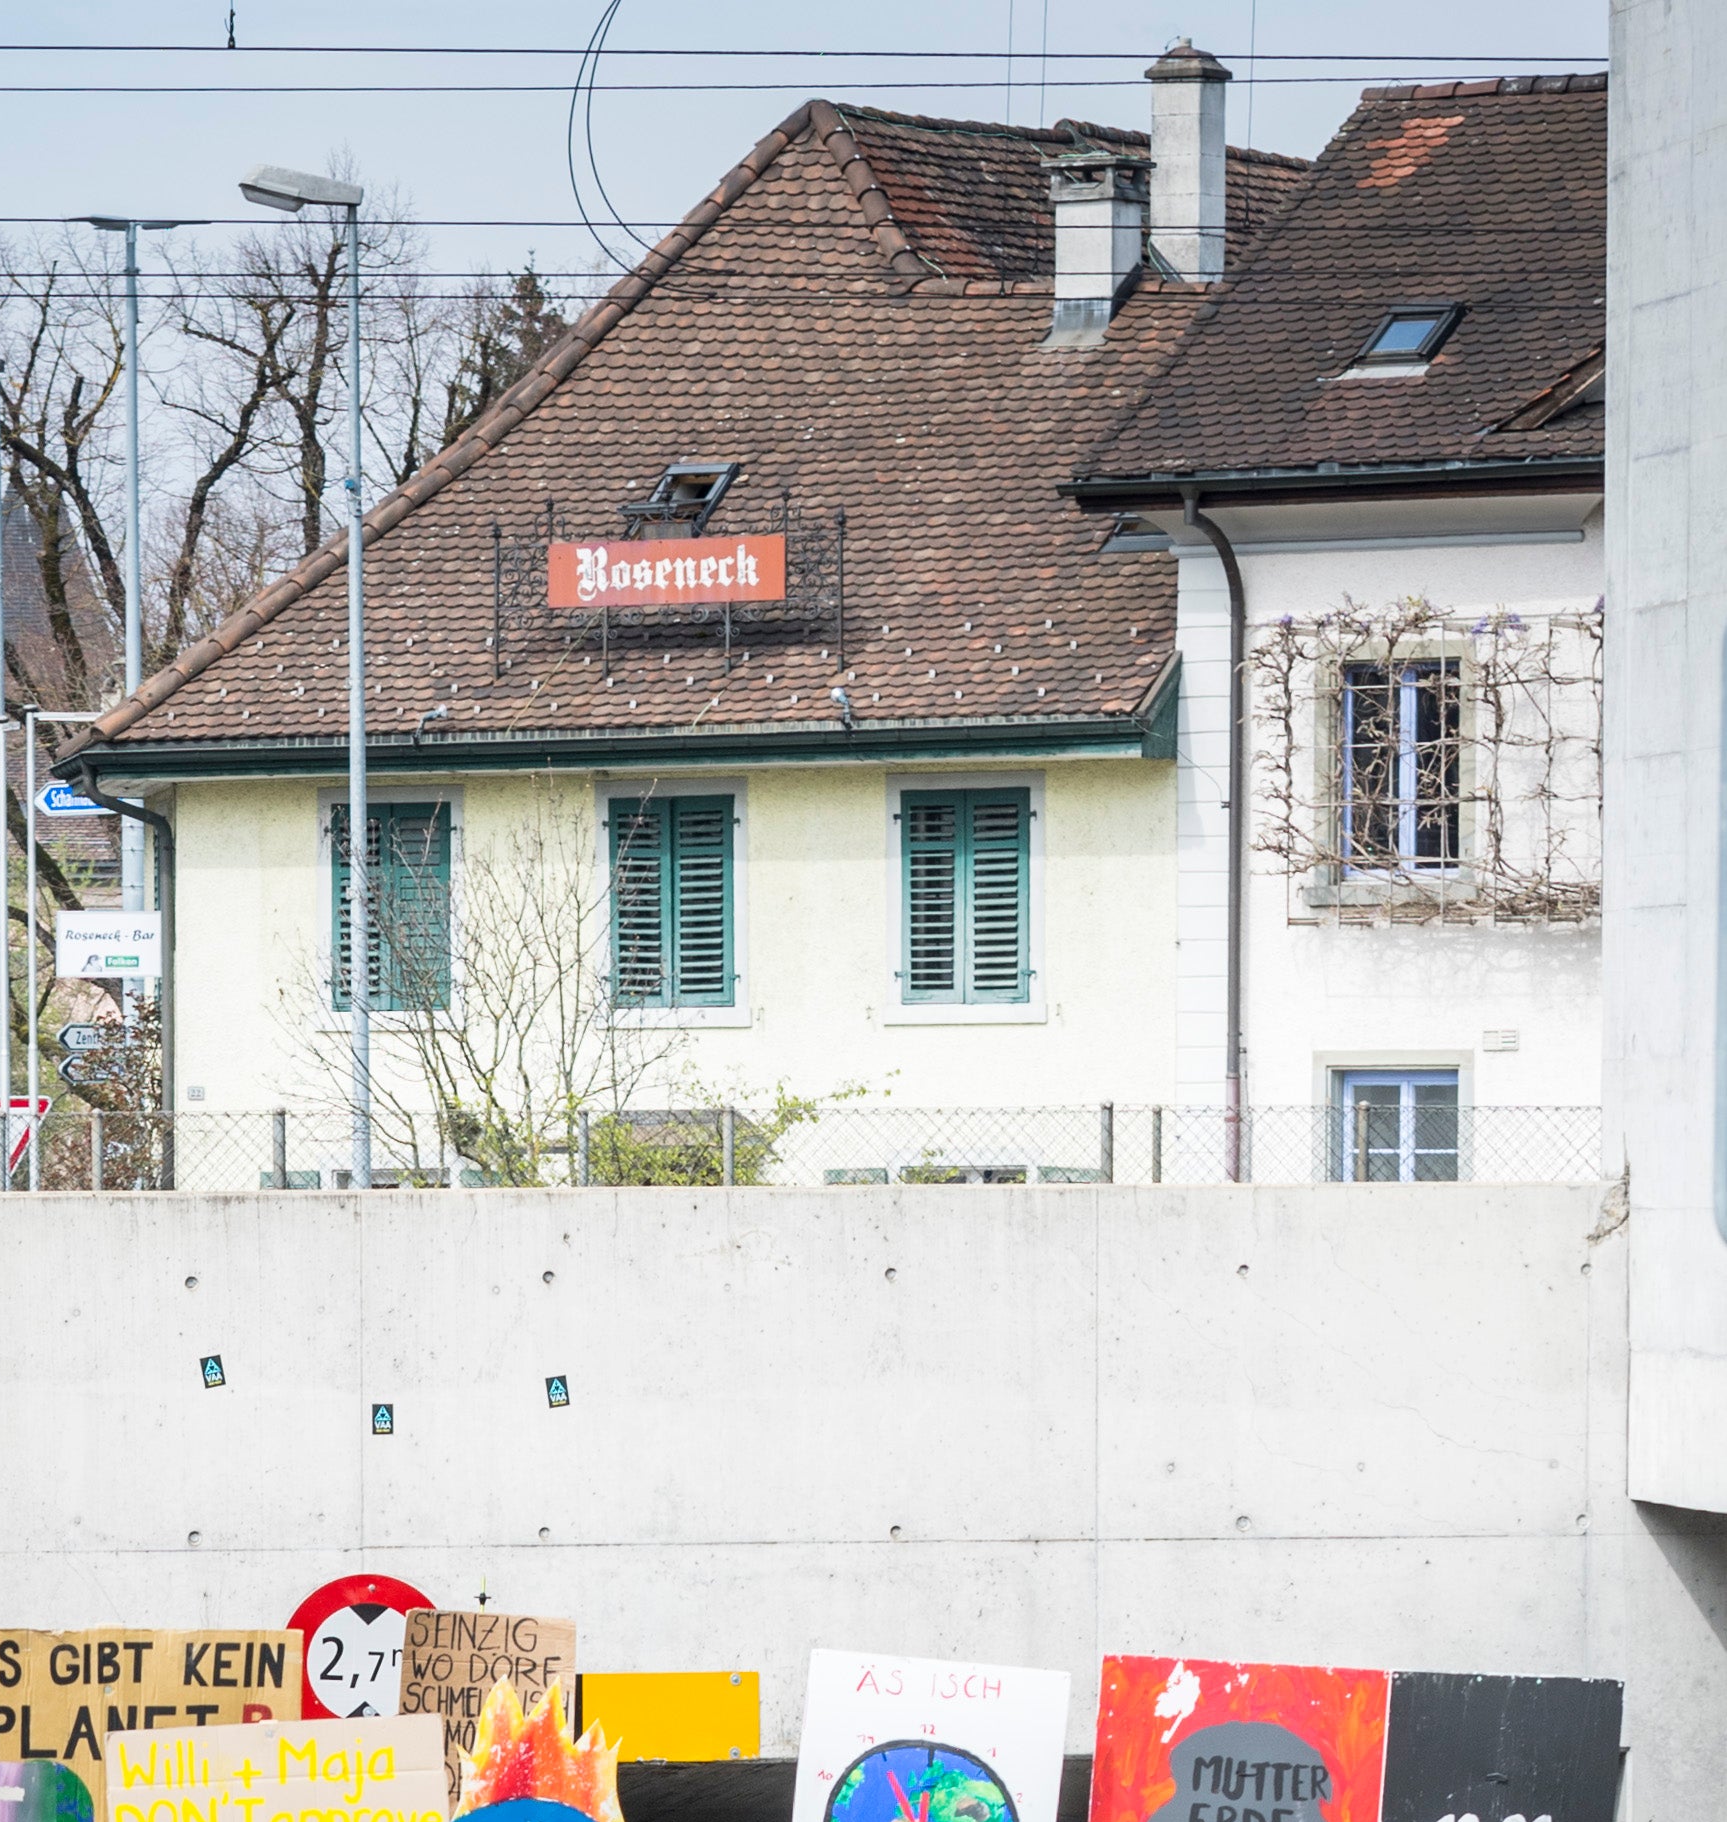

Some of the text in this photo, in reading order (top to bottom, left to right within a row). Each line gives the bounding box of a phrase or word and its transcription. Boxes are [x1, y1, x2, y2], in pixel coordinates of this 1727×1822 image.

[575, 544, 760, 601] Roseneck
[65, 930, 121, 942] Roseneck
[132, 930, 155, 942] Bar
[50, 1641, 153, 1686] GIBT
[183, 1642, 286, 1688] KEIN
[412, 1653, 454, 1682] WO
[931, 1673, 1002, 1700] ISCH
[920, 1724, 937, 1736] 12
[119, 1739, 210, 1790] Willi
[233, 1758, 263, 1789] +
[279, 1737, 396, 1804] Maja
[1192, 1755, 1329, 1801] MUTTER
